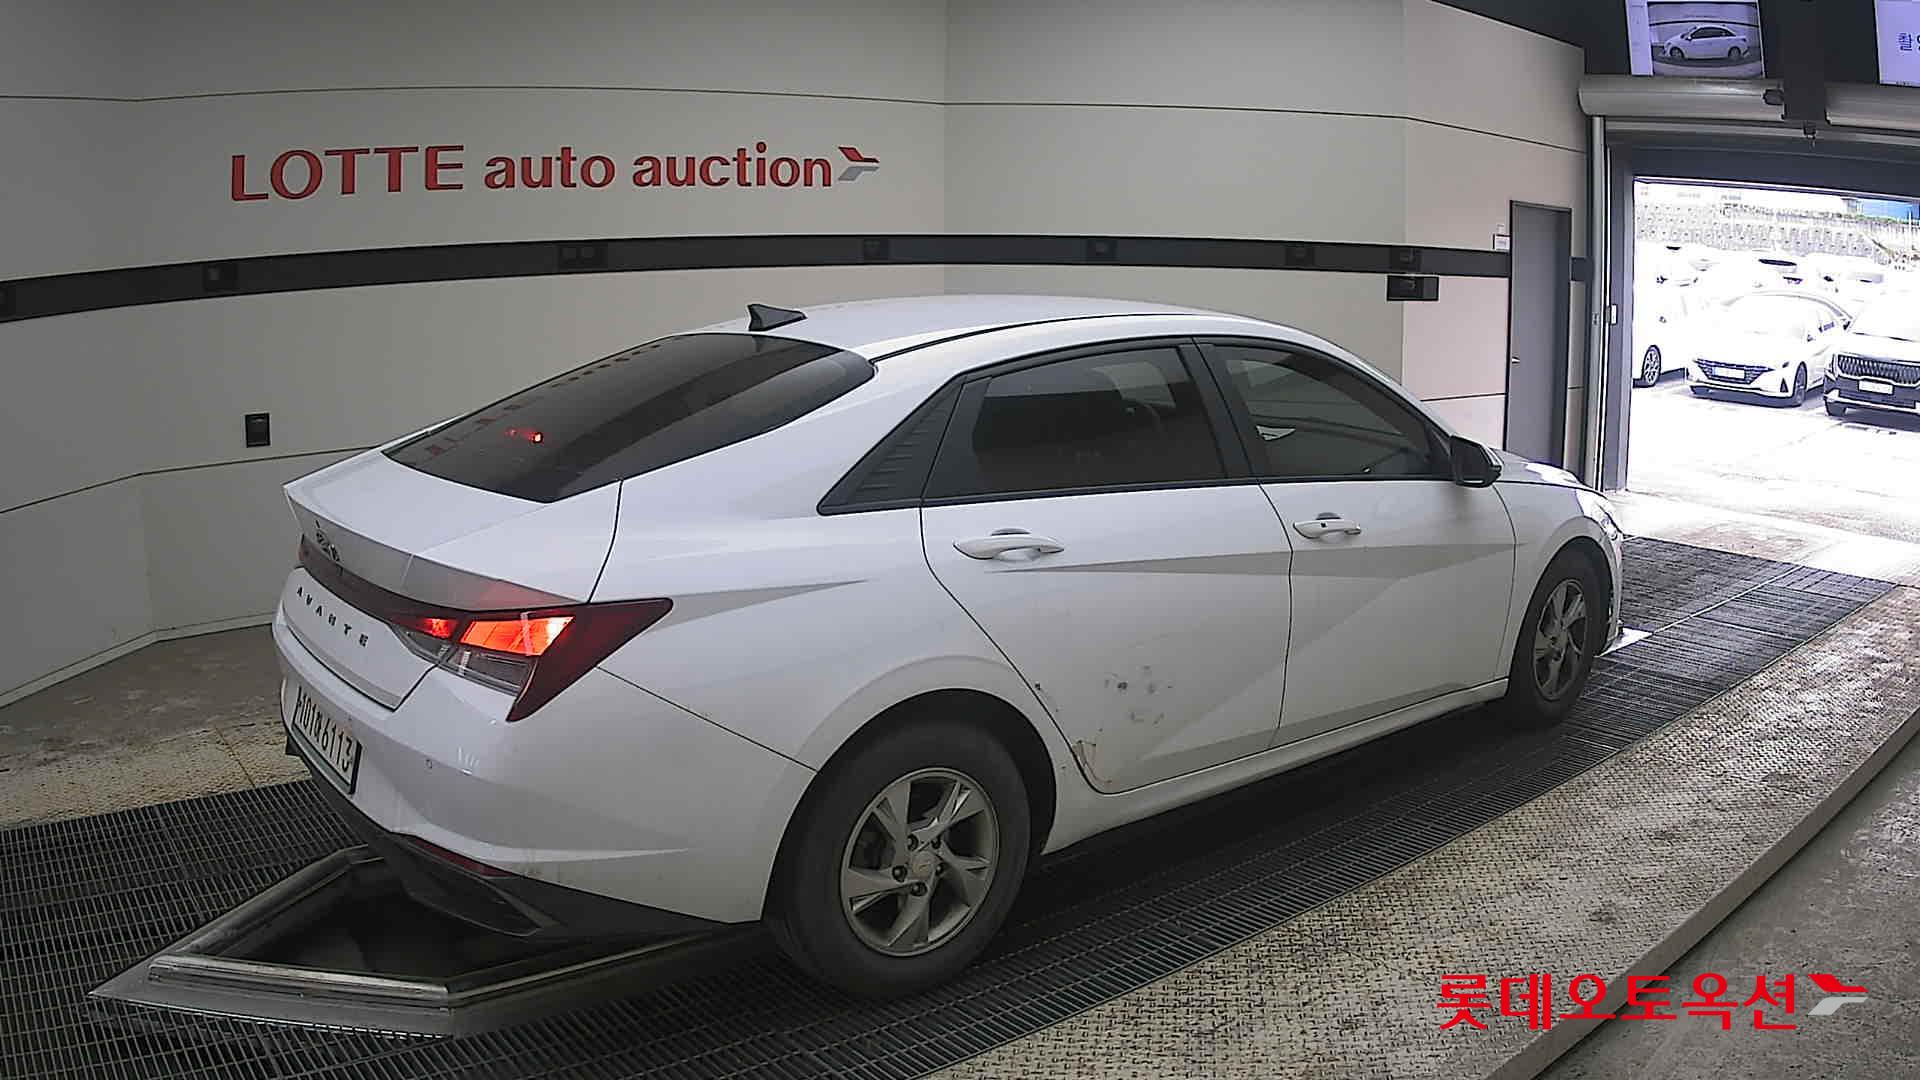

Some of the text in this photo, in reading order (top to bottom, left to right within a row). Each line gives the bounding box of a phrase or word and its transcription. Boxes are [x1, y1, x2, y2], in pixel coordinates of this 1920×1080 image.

[231, 142, 833, 201] LOTTE auto auction
[296, 586, 369, 647] AVANTE
